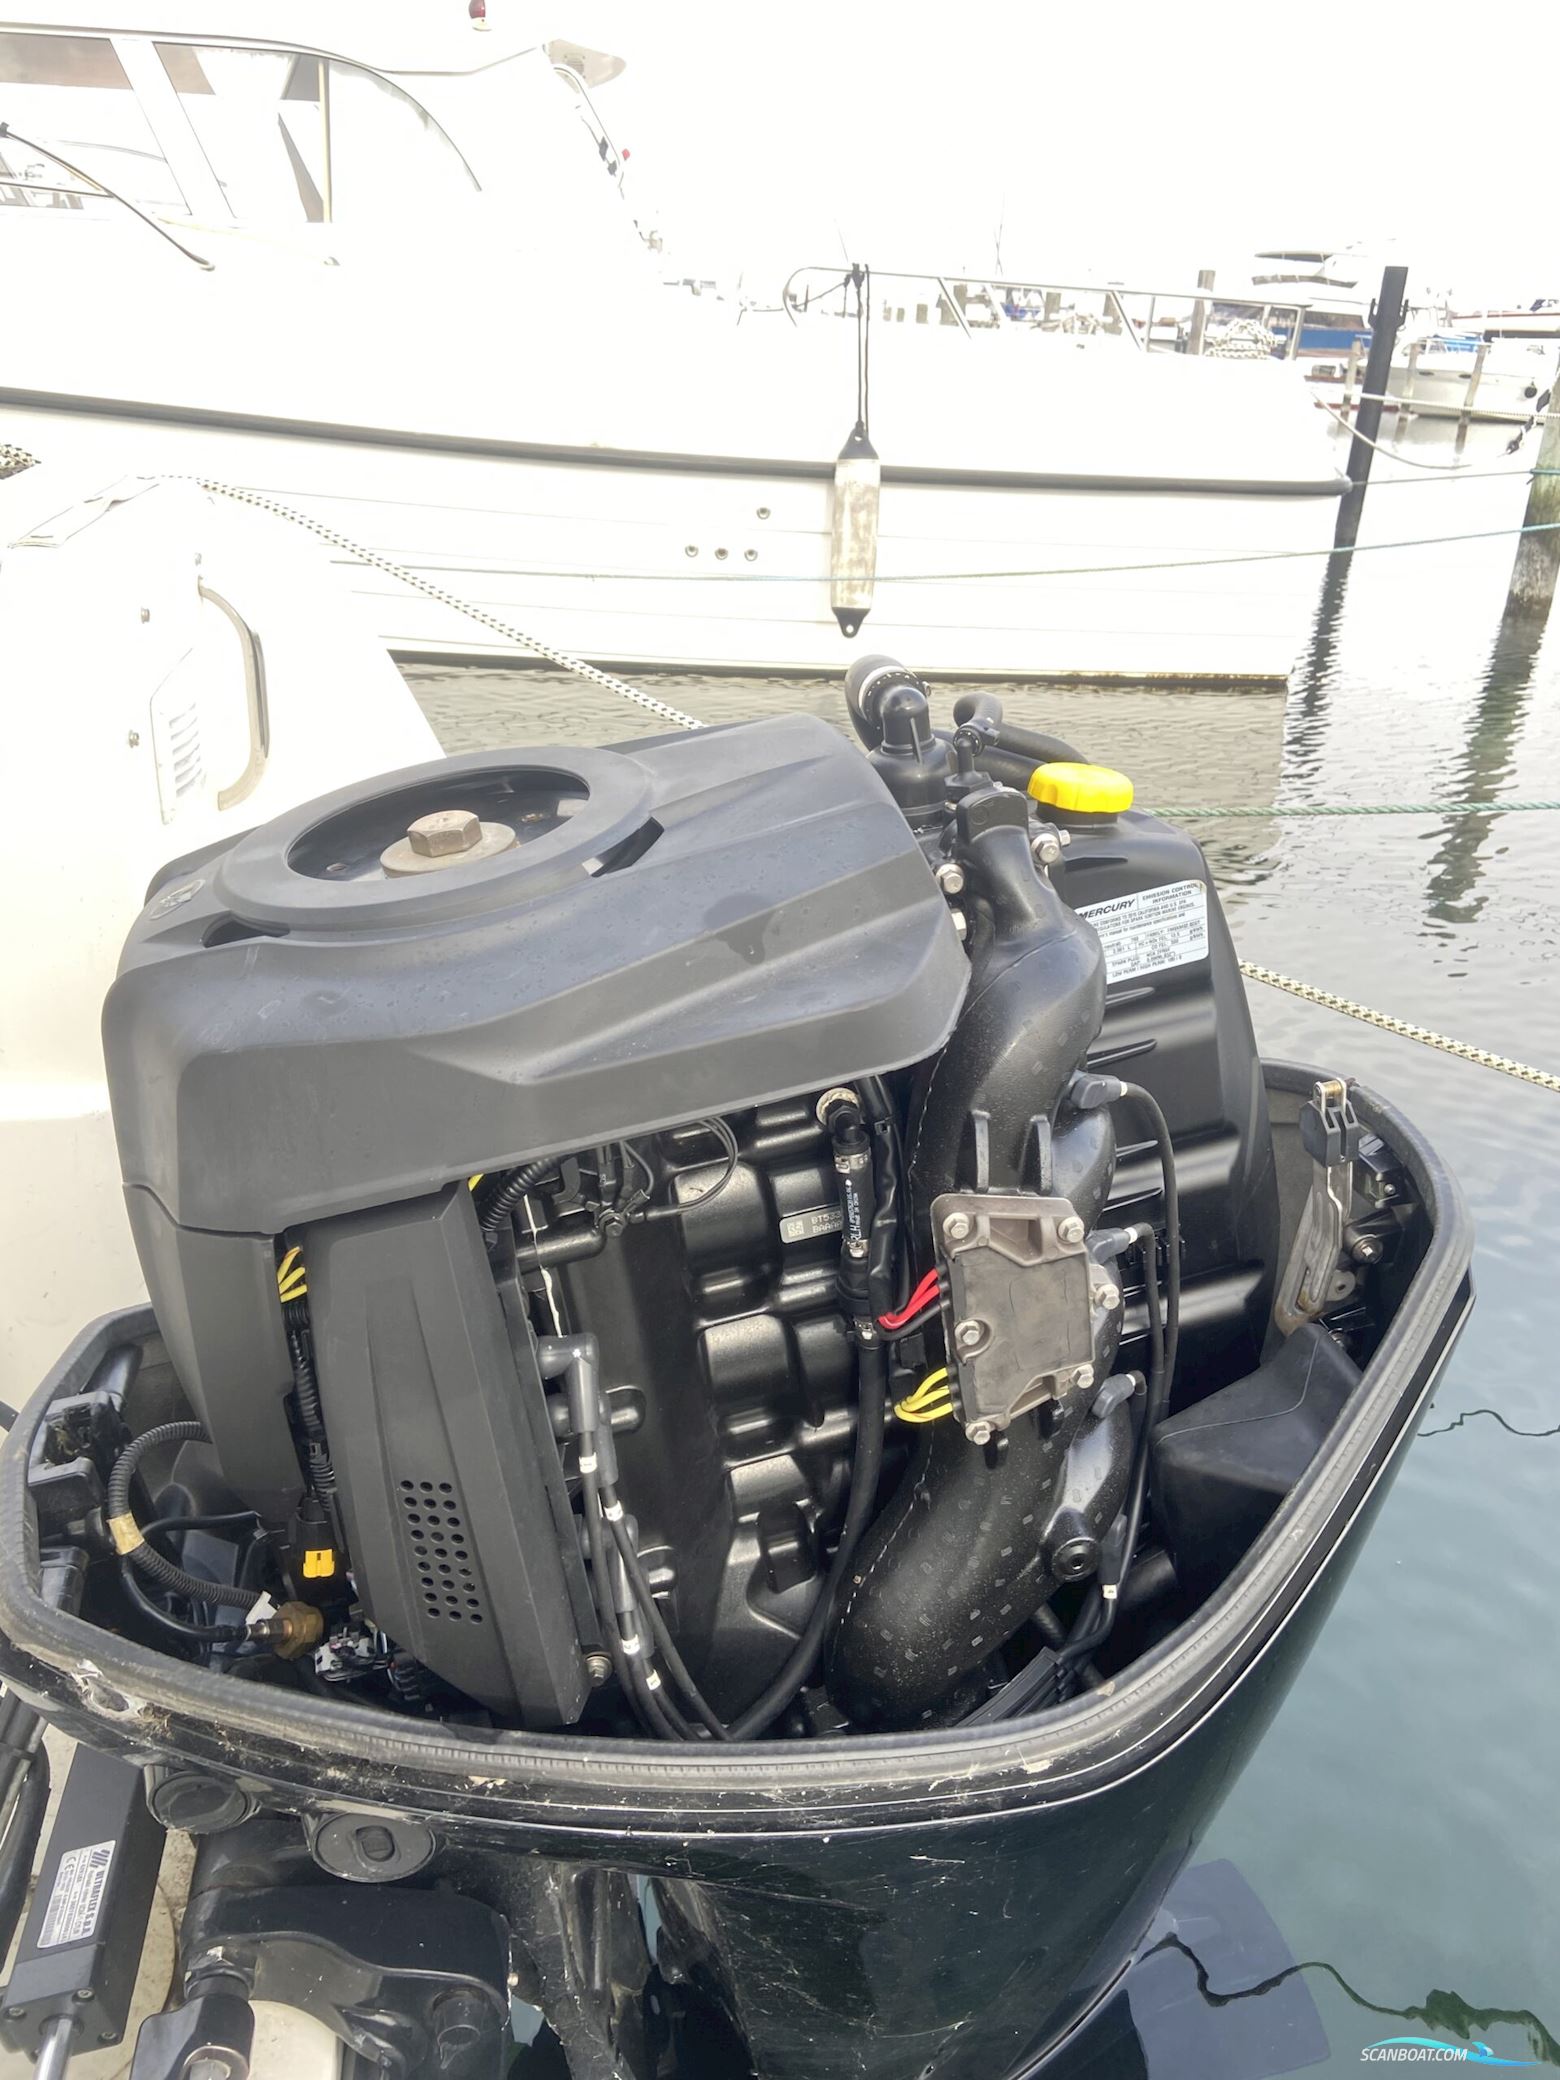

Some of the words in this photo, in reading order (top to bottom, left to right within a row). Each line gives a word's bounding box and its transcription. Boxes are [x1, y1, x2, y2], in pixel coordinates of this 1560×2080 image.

[1142, 889, 1170, 901] EMISSION
[1171, 882, 1199, 894] CONTROL
[1152, 890, 1192, 904] INFORMATION
[1078, 898, 1136, 919] MERCURY
[86, 1869, 106, 1912] ULTRAFLEX
